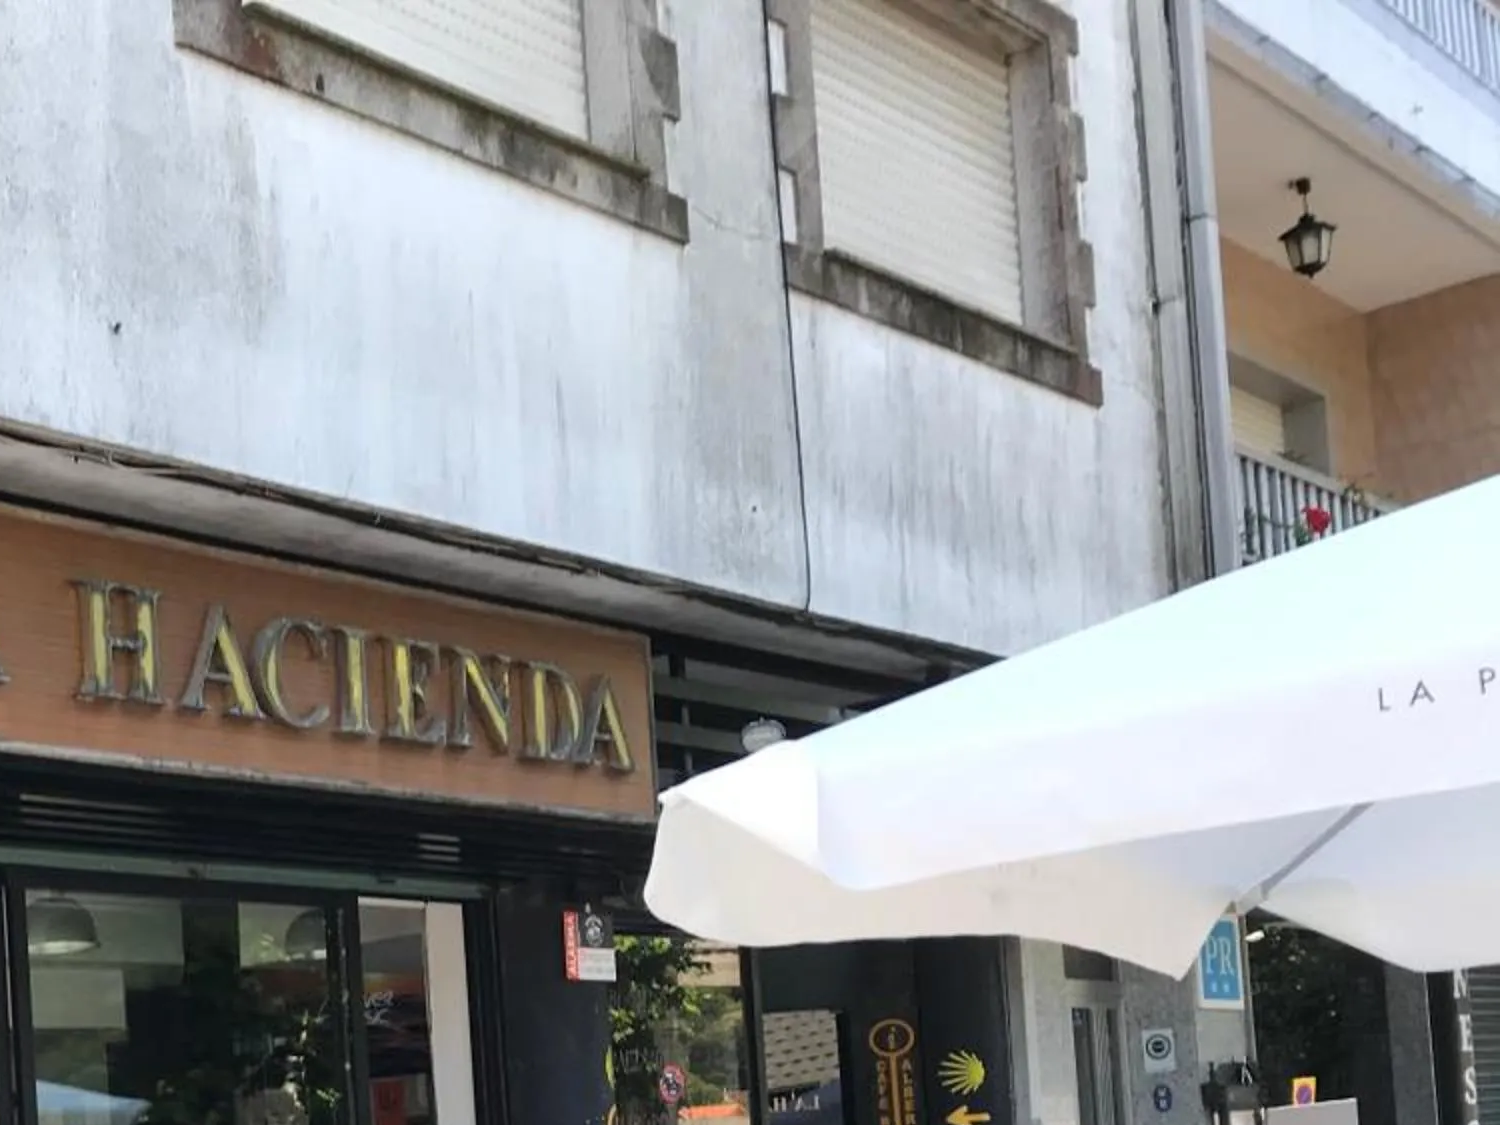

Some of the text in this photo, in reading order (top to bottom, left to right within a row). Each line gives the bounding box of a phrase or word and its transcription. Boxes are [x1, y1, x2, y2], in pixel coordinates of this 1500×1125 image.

[71, 580, 633, 771] HACIENDA
[1378, 680, 1435, 711] LA
[1206, 936, 1235, 977] PR
